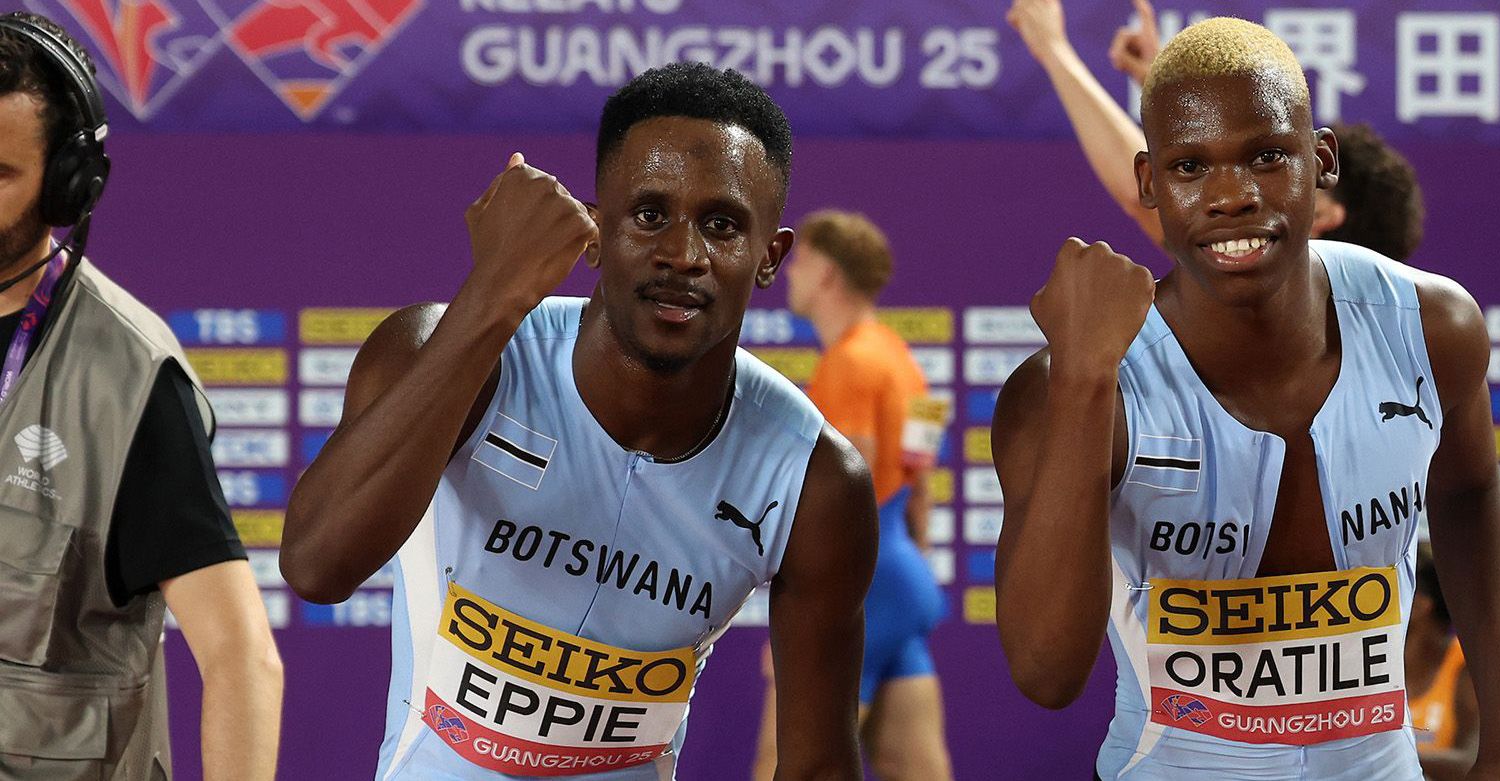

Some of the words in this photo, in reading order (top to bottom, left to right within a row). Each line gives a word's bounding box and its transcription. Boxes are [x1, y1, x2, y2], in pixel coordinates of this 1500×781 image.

[462, 25, 902, 87] GUANGZHOU
[920, 28, 999, 89] 25
[5, 475, 57, 498] ATHLECS
[17, 466, 50, 486] WORD
[484, 519, 714, 619] BOTSWANA
[1159, 573, 1391, 636] SEIKO
[448, 597, 688, 697] SEIKO
[1164, 634, 1390, 698] ORATILE
[455, 661, 648, 743] EPPIE
[1217, 708, 1366, 734] GUANGZHOU
[1369, 704, 1396, 724] 25
[472, 736, 622, 770] GUANGZHOU
[628, 750, 653, 764] 25
